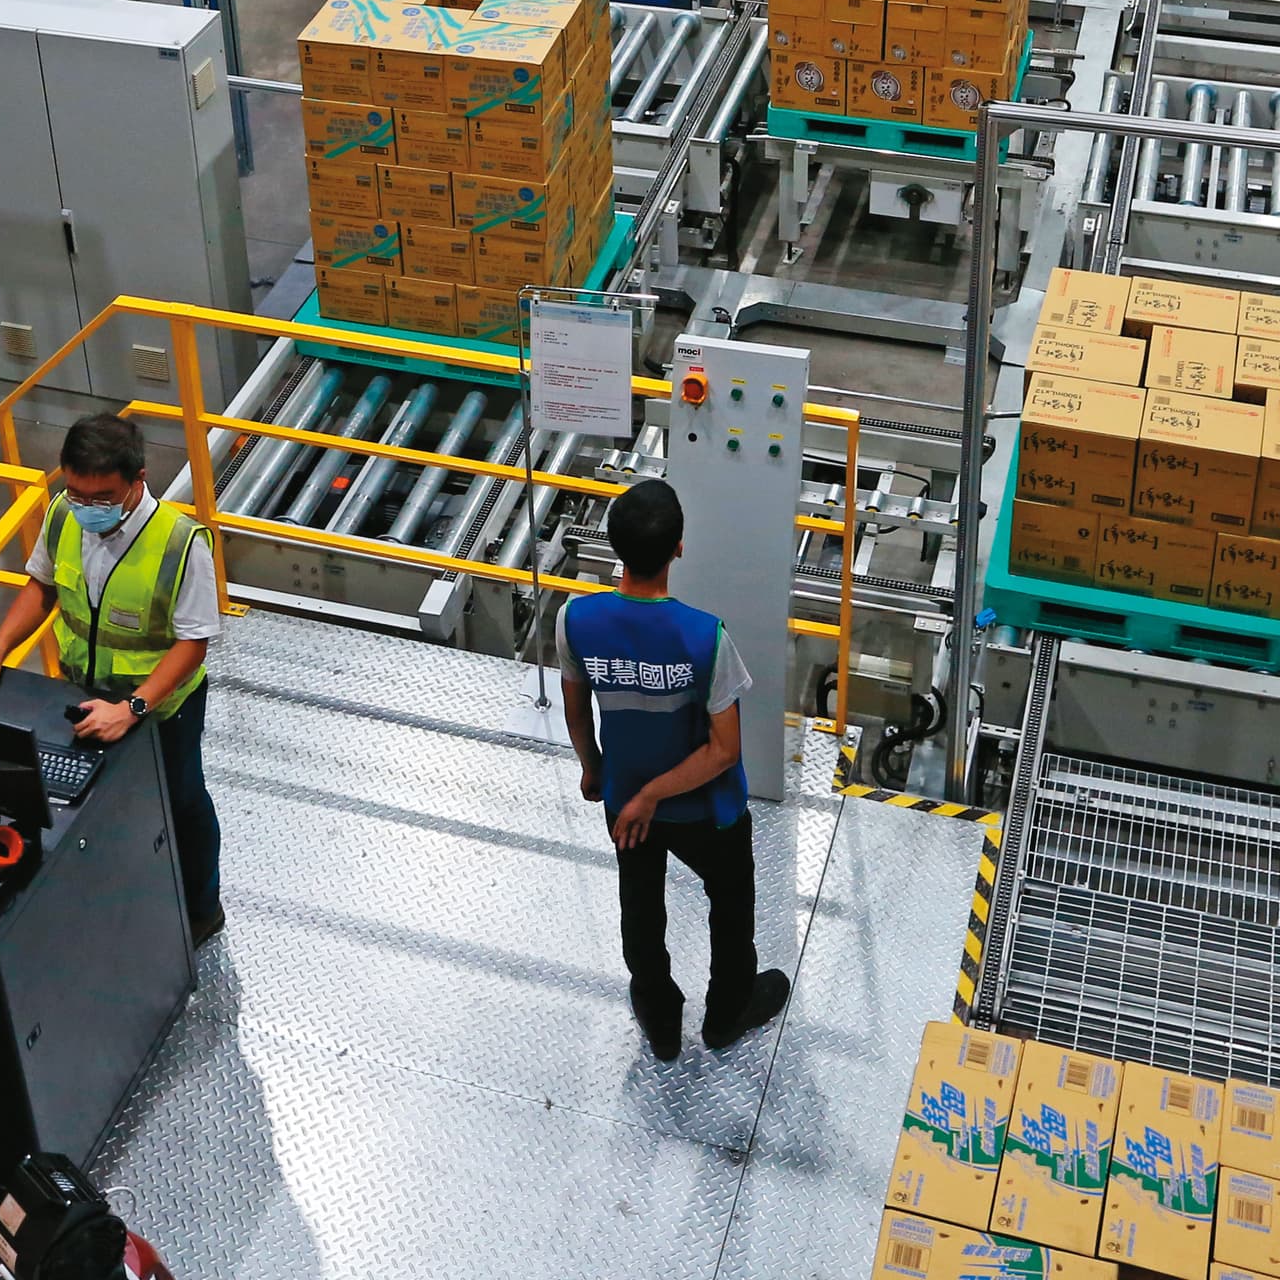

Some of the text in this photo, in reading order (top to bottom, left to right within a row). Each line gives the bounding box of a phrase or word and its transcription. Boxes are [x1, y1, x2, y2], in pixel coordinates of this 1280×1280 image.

[678, 347, 700, 356] moci
[583, 657, 695, 690] 東慧國際
[921, 1080, 967, 1131] 舒跑
[1022, 1104, 1068, 1156] 舒跑
[1125, 1127, 1171, 1181] 舒跑
